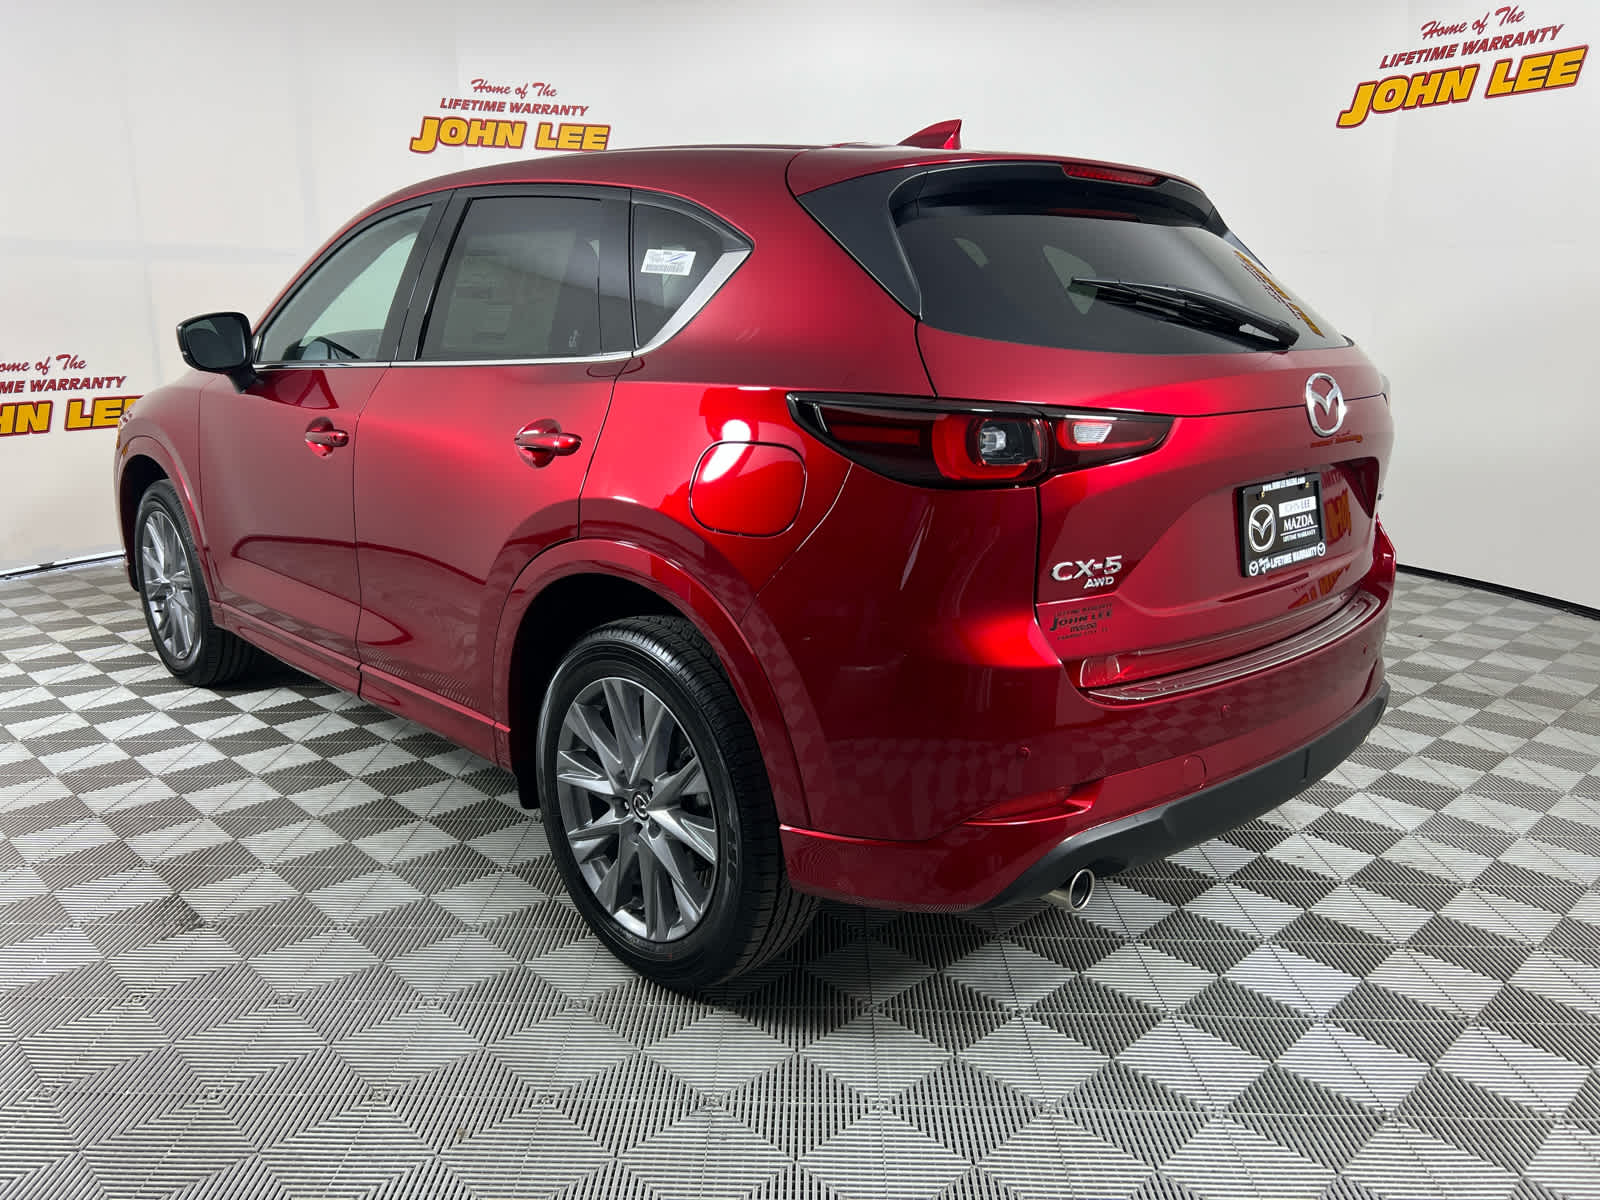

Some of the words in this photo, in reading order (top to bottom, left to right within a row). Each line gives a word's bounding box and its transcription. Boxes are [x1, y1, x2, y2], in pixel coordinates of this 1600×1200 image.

[1420, 20, 1467, 40] Home
[1471, 12, 1490, 35] of
[1494, 5, 1525, 26] The
[1379, 43, 1459, 69] LIFETIME
[1461, 23, 1564, 56] WARRANTY
[471, 78, 511, 95] Home
[514, 83, 528, 99] of
[532, 82, 557, 97] The
[1336, 63, 1480, 129] JOHN
[1484, 44, 1589, 99] LEE
[439, 97, 506, 112] LIFETIME
[509, 101, 589, 117] WARRANTY
[409, 115, 528, 154] JOHN
[534, 121, 611, 152] LEE
[35, 356, 51, 375] of
[55, 354, 87, 370] The
[30, 376, 127, 393] WARRANTY
[1283, 513, 1314, 532] MAZDA
[1051, 555, 1122, 581] CX-5
[1083, 576, 1114, 589] AWD
